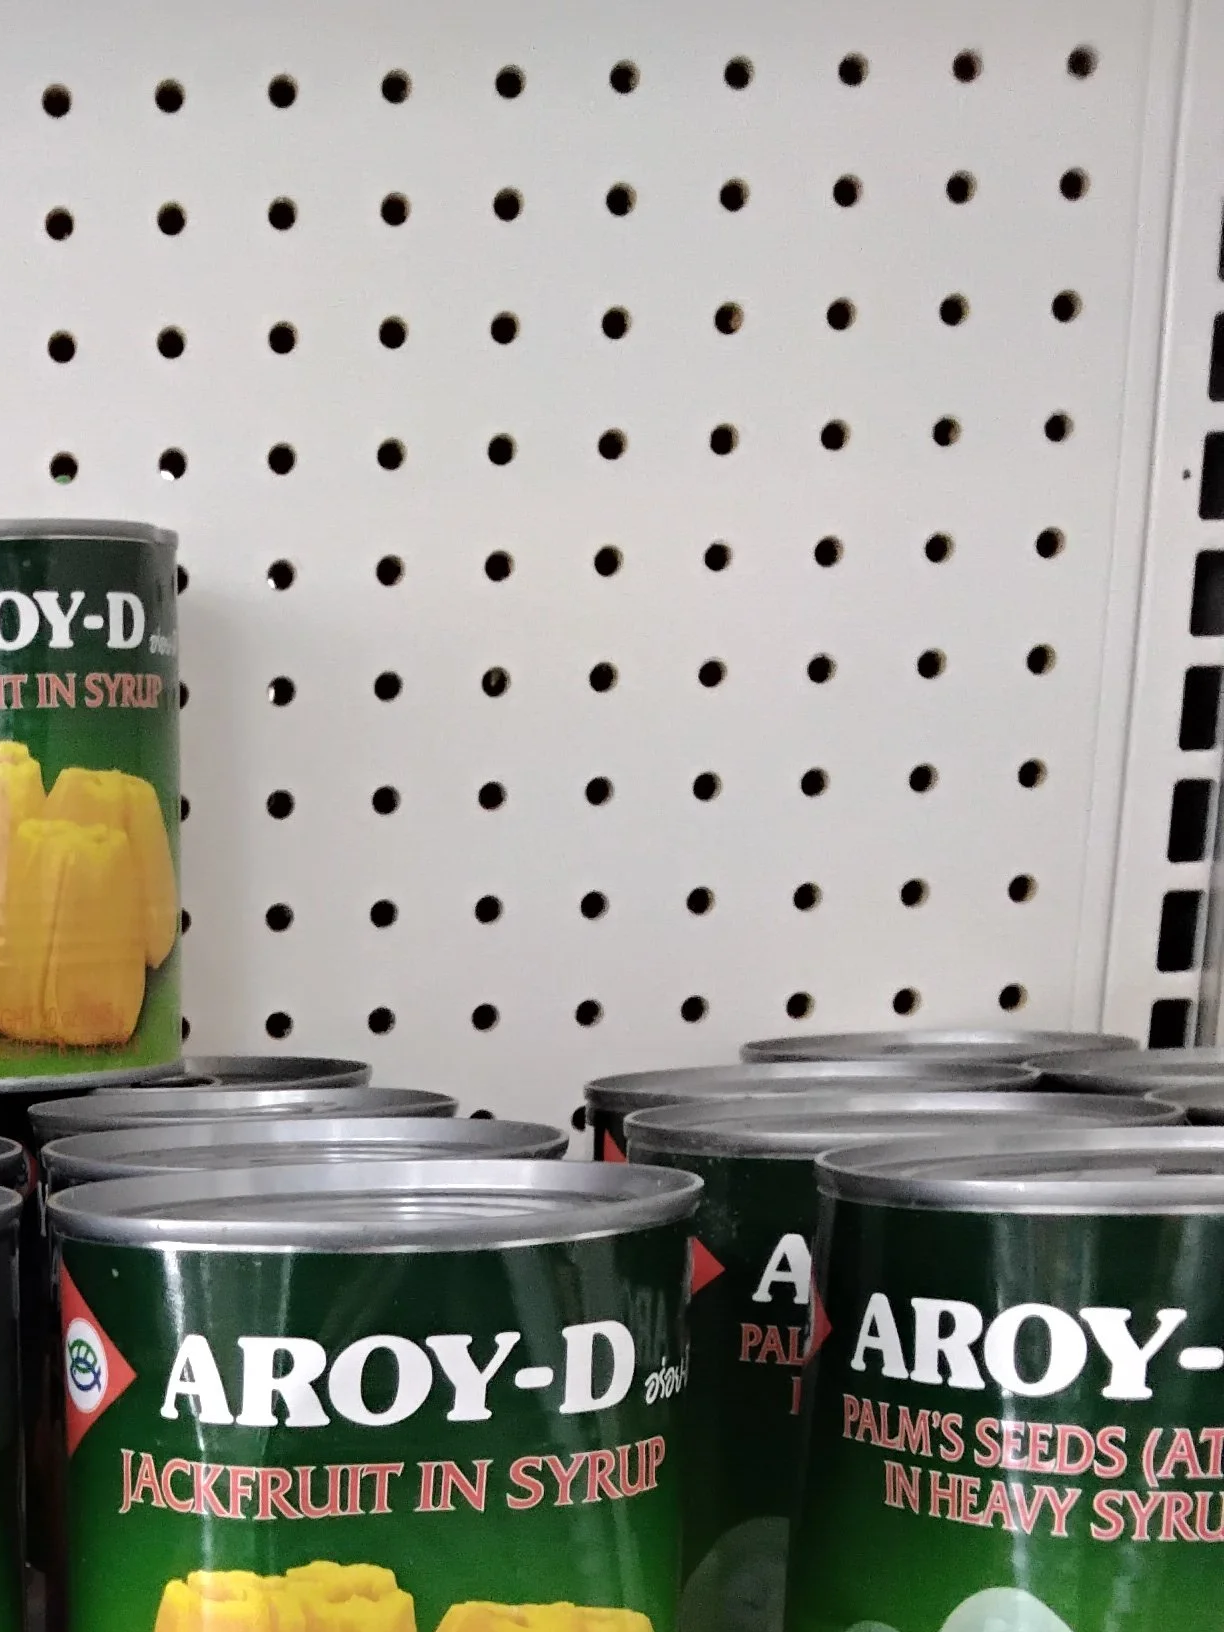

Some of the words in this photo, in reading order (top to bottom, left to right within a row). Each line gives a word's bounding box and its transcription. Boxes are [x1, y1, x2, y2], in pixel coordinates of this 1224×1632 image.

[36, 673, 76, 708] IN
[85, 673, 163, 708] SYRUP
[161, 1320, 636, 1427] AROY-D
[842, 1394, 965, 1463] PALM'S
[974, 1416, 1127, 1477] SEEDS
[120, 1448, 405, 1521] JACKFRUIT
[415, 1459, 495, 1513] IN
[506, 1436, 666, 1511] SYRUP
[883, 1460, 922, 1516] IN
[928, 1470, 1082, 1538] HEAVY
